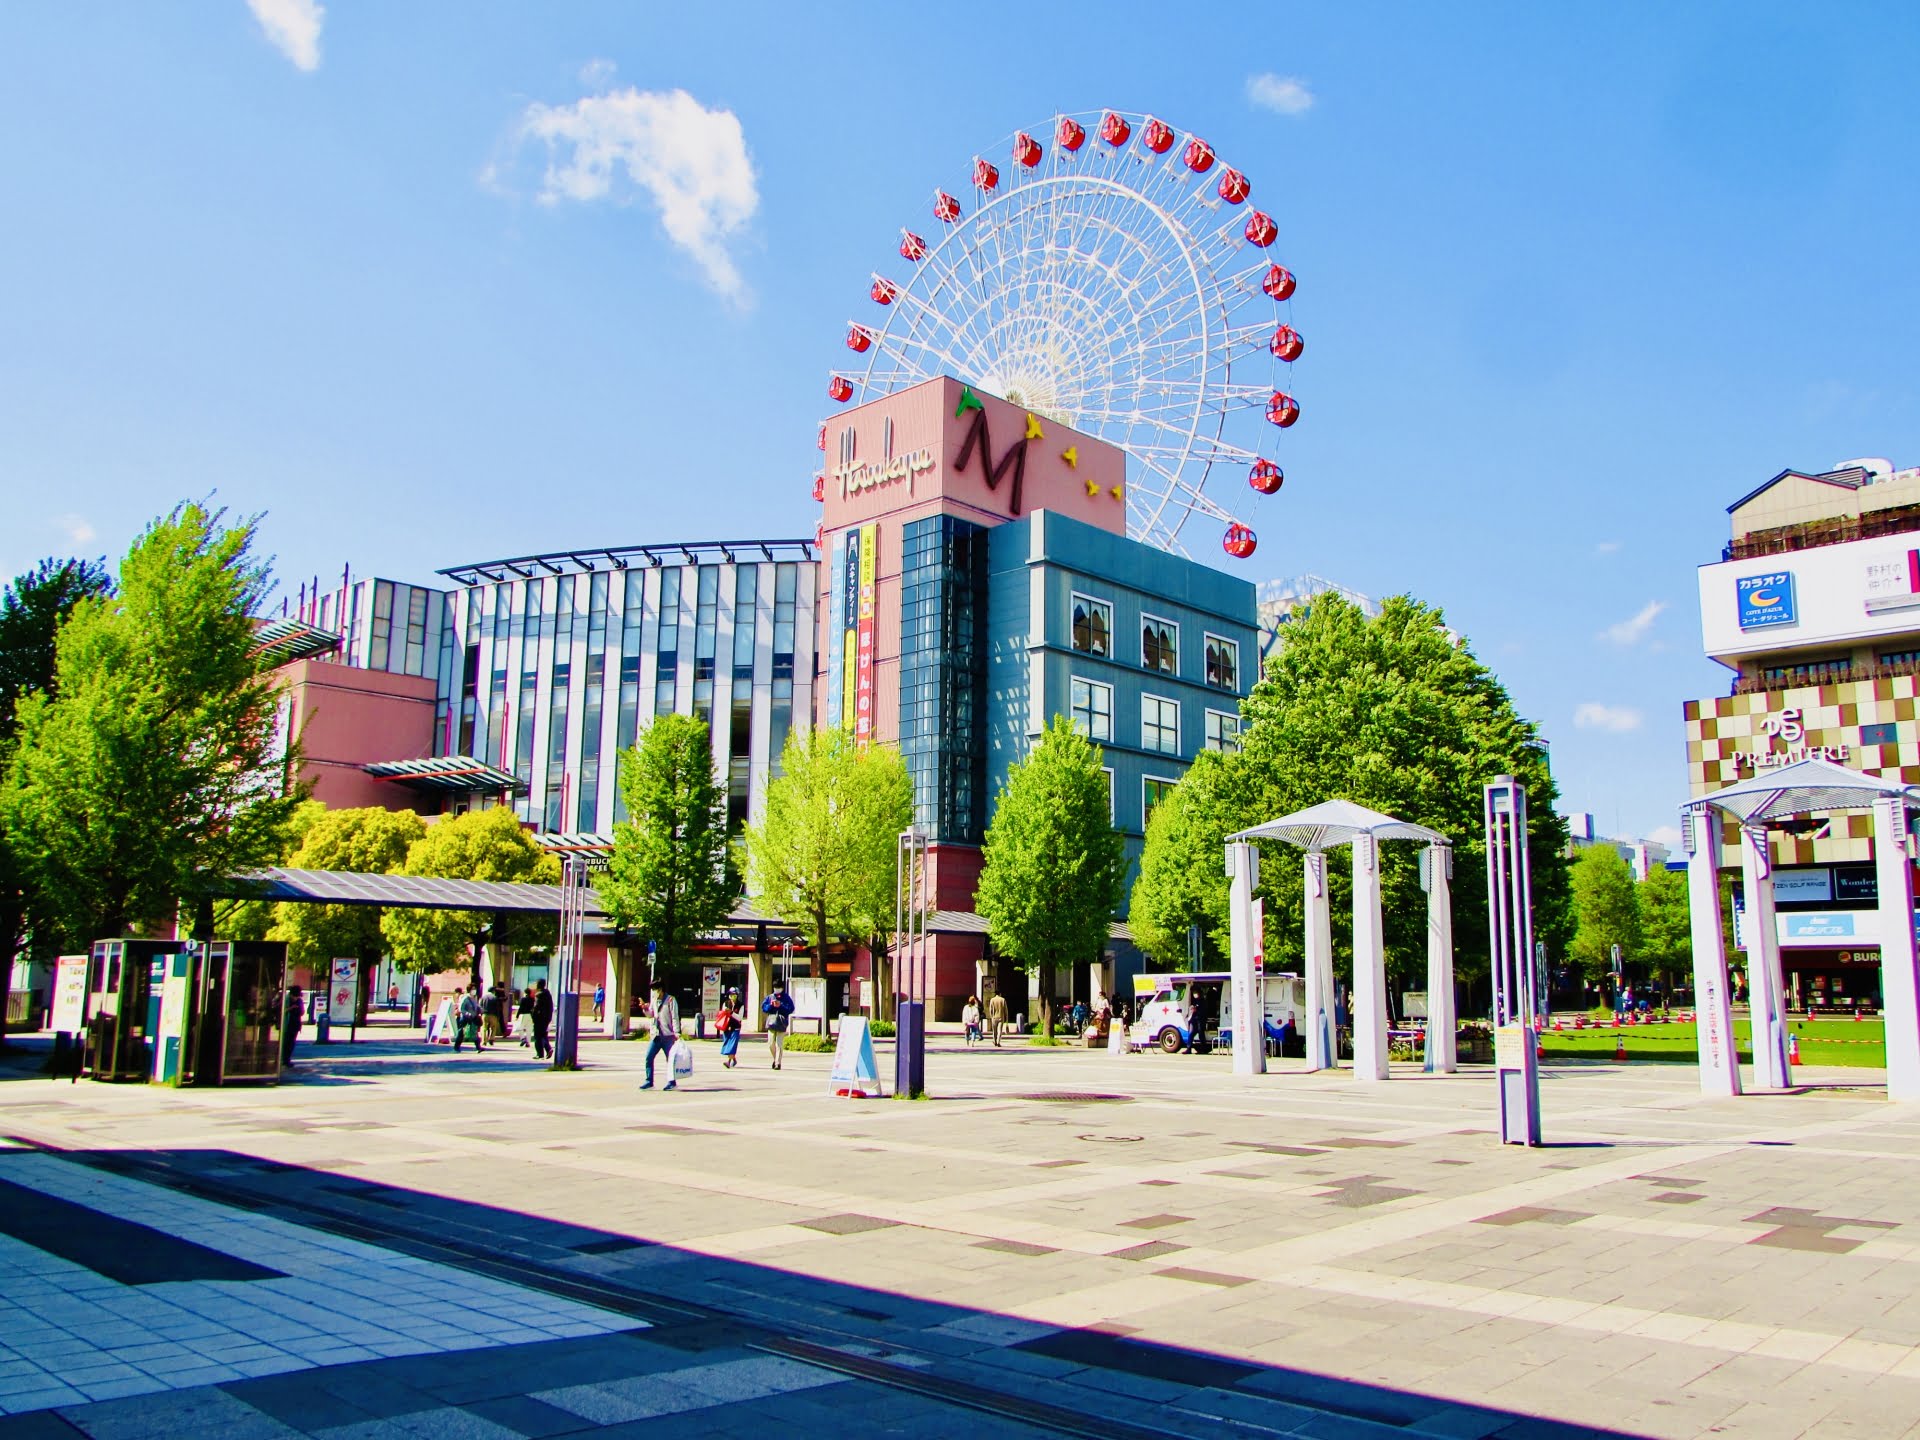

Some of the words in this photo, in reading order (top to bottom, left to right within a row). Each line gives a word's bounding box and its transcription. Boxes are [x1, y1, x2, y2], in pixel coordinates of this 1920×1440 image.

[1740, 575, 1788, 590] カラオケ
[1731, 744, 1850, 769] PREMIERE
